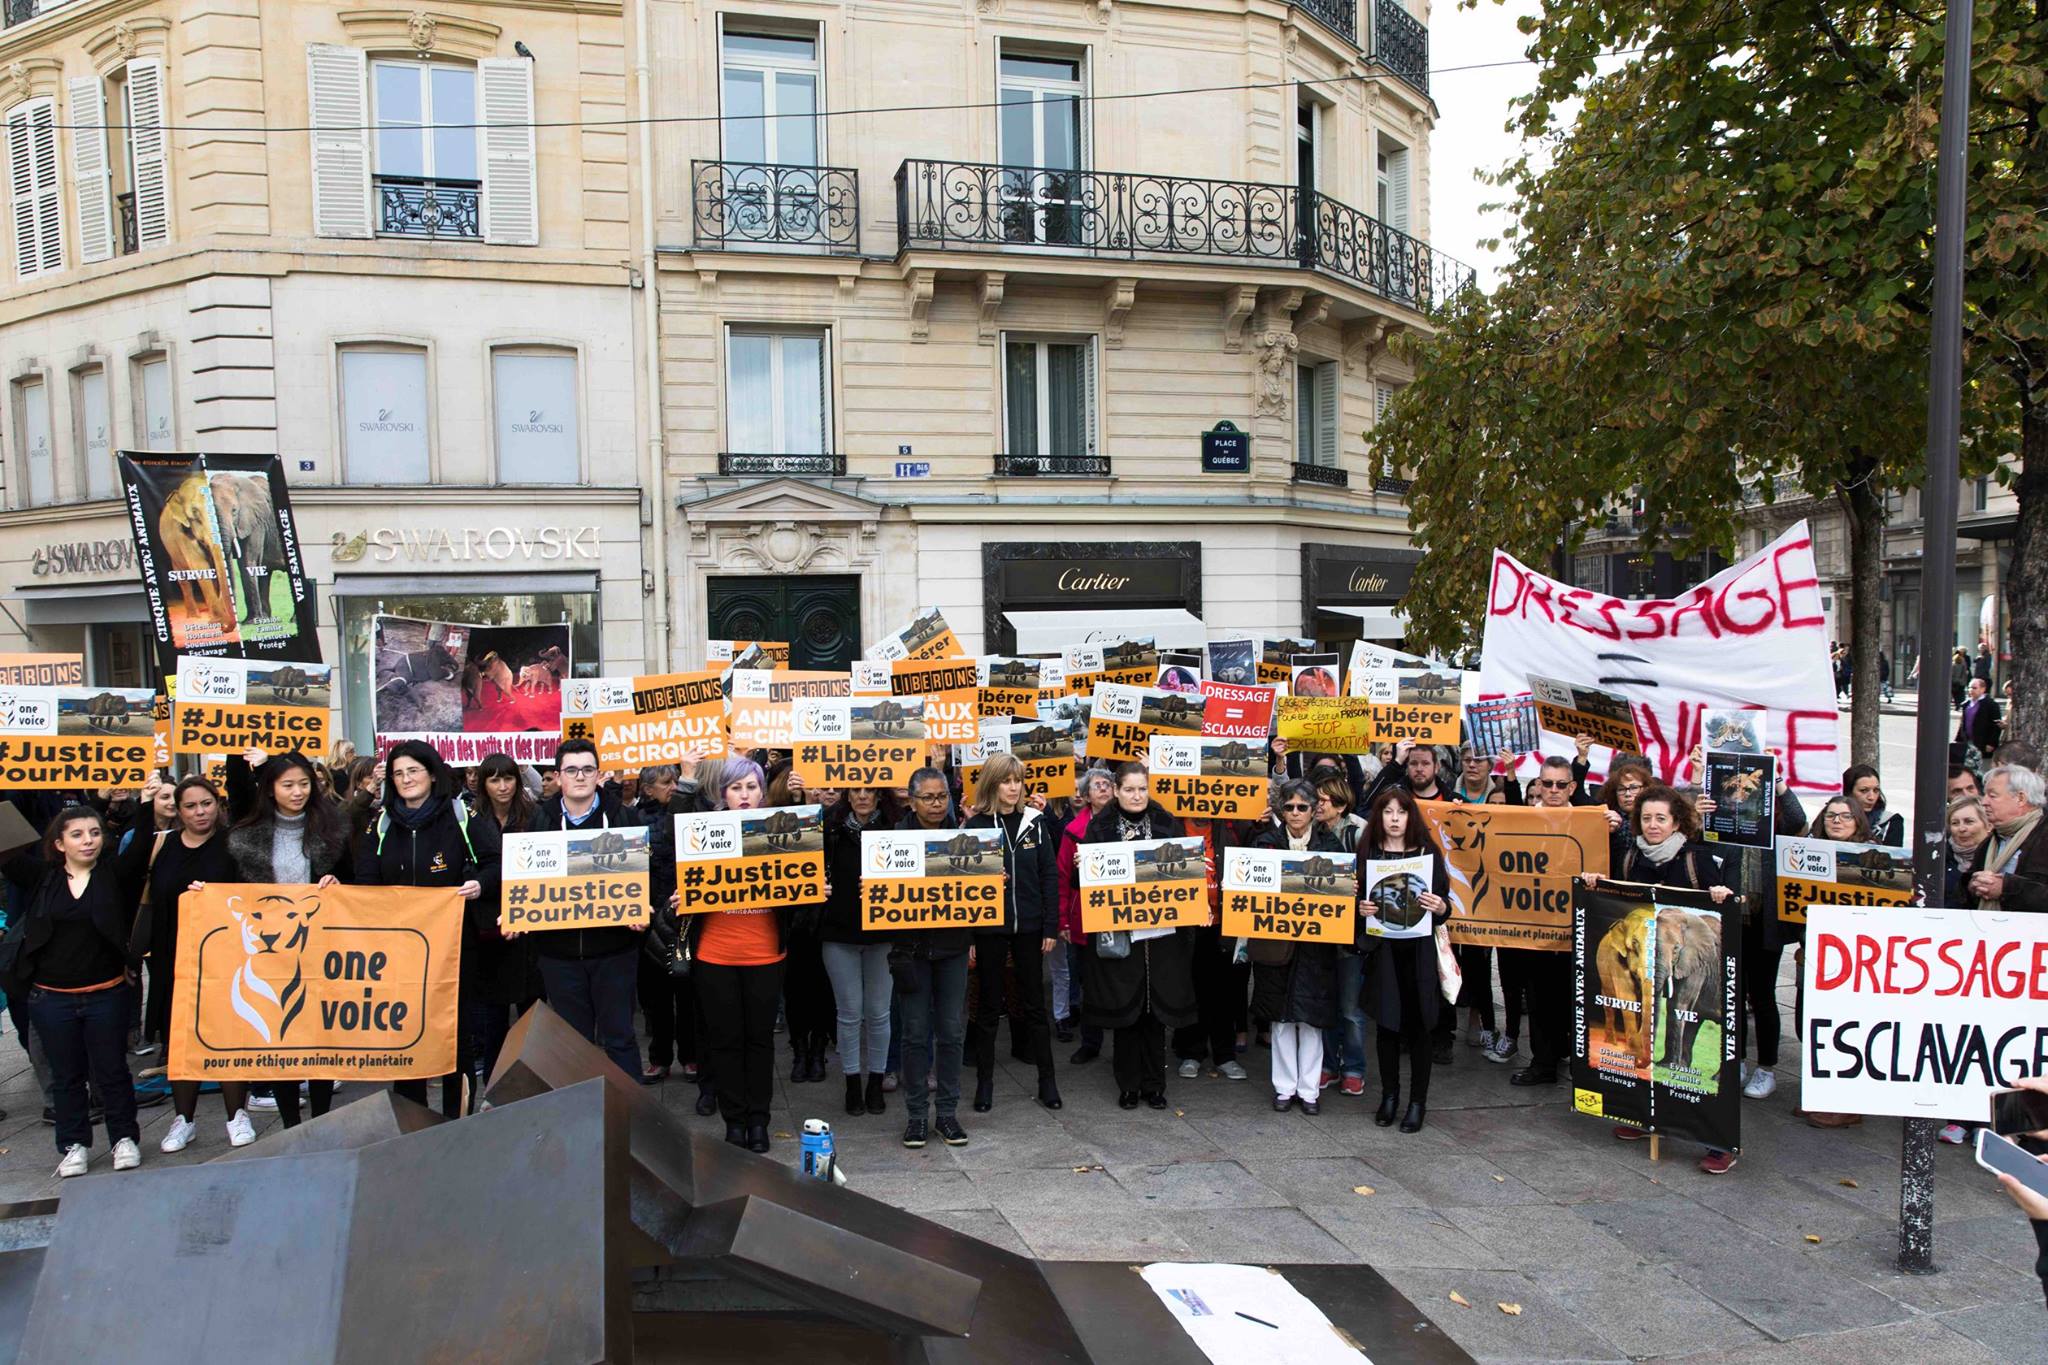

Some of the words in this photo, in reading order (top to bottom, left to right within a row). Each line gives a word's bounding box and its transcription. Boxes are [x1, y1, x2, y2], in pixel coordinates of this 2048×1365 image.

[360, 423, 414, 432] SWAROVSKI
[512, 424, 563, 433] SWAROVSKI
[304, 462, 311, 470] 3
[1212, 456, 1240, 464] QUÉBEC
[127, 484, 149, 546] ANIMAUX
[279, 509, 301, 575] SAUVAGE
[373, 527, 600, 561] SWAROVSKI
[51, 538, 139, 574] SWAROV
[140, 547, 158, 589] AVEC
[168, 569, 217, 582] SURVIE
[246, 566, 268, 578] VIE
[1058, 567, 1130, 591] Cartier
[1348, 565, 1389, 592] Cartier
[290, 576, 305, 602] VIE
[1490, 538, 1825, 640] DRESSAGE
[151, 591, 169, 642] CIRQUE
[189, 648, 228, 657] Esclavage
[258, 641, 287, 650] Protégé
[213, 675, 229, 684] one
[213, 686, 236, 695] voice
[978, 689, 1033, 704] ibérer
[1205, 685, 1270, 702] DRESSAGE
[19, 705, 38, 714] one
[668, 709, 686, 718] LES
[735, 709, 793, 727] ANIM
[1116, 706, 1133, 715] voice
[1372, 707, 1453, 724] Libérer
[19, 716, 45, 725] voice
[181, 708, 323, 731] #Justice
[822, 724, 842, 732] voice
[1302, 720, 1341, 736] STOP
[1541, 705, 1633, 739] #Justice
[600, 716, 721, 746] ANIMAUX
[1201, 722, 1268, 737] SCLAVAGE
[181, 729, 321, 751] PourMaya
[456, 735, 475, 762] des
[476, 736, 502, 762] petits
[504, 736, 515, 759] et
[515, 735, 533, 761] des
[534, 734, 563, 762] grand
[601, 752, 622, 762] DES
[623, 737, 724, 764] CIRQUES
[801, 743, 917, 763] #Libérer
[1176, 759, 1193, 767] voice
[825, 764, 894, 784] Maya
[1156, 778, 1260, 797] #Libérer
[1176, 796, 1238, 815] Maya
[710, 829, 726, 838] one
[536, 848, 551, 857] one
[710, 839, 732, 850] voice
[894, 849, 909, 857] one
[536, 858, 557, 868] voice
[894, 860, 915, 868] voice
[1107, 858, 1121, 866] one
[1500, 850, 1549, 874] one
[1807, 854, 1821, 862] one
[684, 860, 818, 887] #Justice
[1107, 867, 1127, 876] voice
[1253, 873, 1272, 883] voice
[1807, 865, 1827, 873] voice
[508, 880, 642, 905] #Justice
[685, 882, 818, 907] PourMaya
[869, 882, 997, 904] #Justice
[1089, 885, 1199, 907] #Libérer
[1501, 878, 1570, 913] voice
[508, 902, 642, 924] PourMaya
[869, 904, 997, 923] PourMaya
[1112, 905, 1179, 925] Maya
[1231, 895, 1346, 918] #Libérer
[1253, 915, 1322, 938] Maya
[1456, 922, 1486, 935] éthique
[1488, 926, 1521, 937] animale
[1523, 930, 1531, 938] et
[1576, 908, 1586, 967] ANIMAUX
[323, 950, 387, 981] one
[1815, 933, 2048, 1000] DRESSAGE
[1575, 969, 1586, 1005] AVEC
[1726, 956, 1737, 1030] SAUVAGE
[321, 987, 408, 1031] voice
[1594, 994, 1642, 1013] SURVIE
[1674, 1008, 1699, 1024] VIE
[1575, 1008, 1585, 1058] CIRQUE
[1726, 1032, 1736, 1062] VIE
[203, 1056, 230, 1070] pour
[233, 1057, 253, 1068] une
[255, 1053, 299, 1070] éthique
[301, 1052, 344, 1067] animale
[346, 1055, 357, 1067] et
[358, 1053, 414, 1069] planétaire
[1600, 1056, 1636, 1070] Isolement
[1670, 1062, 1701, 1075] Evasion
[1598, 1065, 1638, 1079] Soumission
[1600, 1073, 1637, 1088] Esclavage
[1670, 1071, 1701, 1085] Famille
[1662, 1079, 1709, 1095] Majestueux
[1669, 1089, 1701, 1103] Protégé
